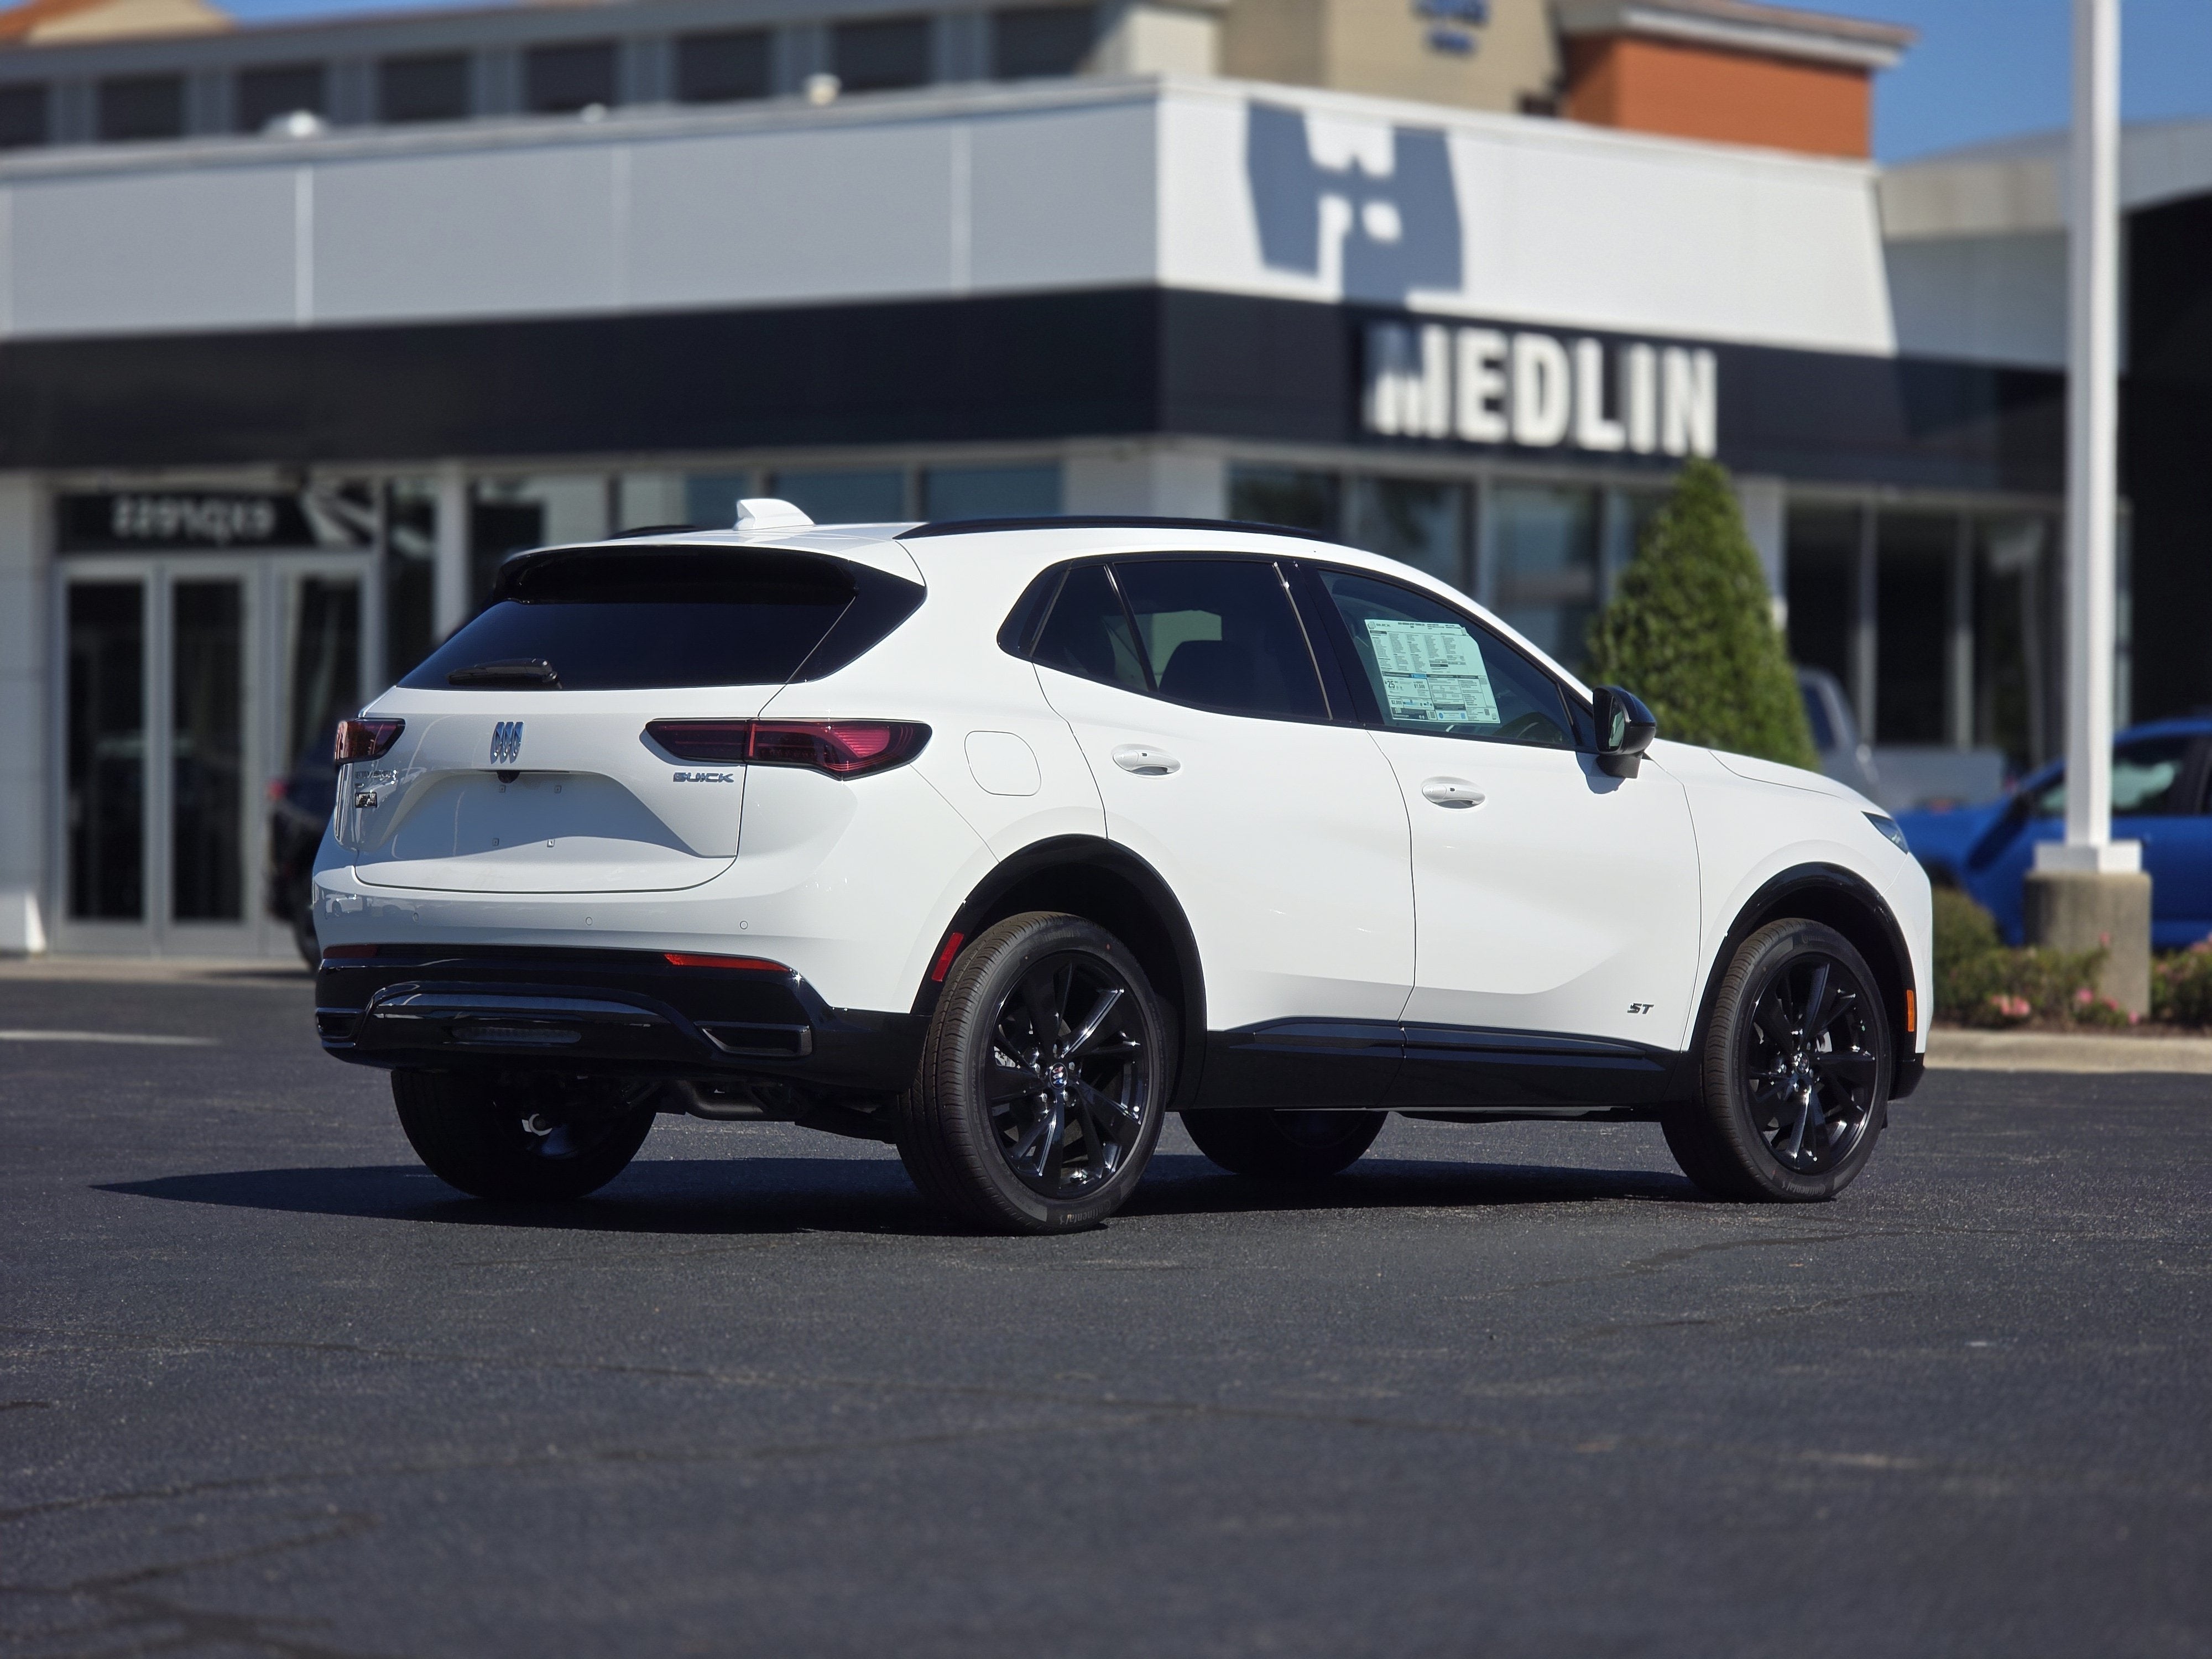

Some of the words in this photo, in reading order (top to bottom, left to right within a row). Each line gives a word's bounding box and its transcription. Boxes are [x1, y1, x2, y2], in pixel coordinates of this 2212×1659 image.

[1366, 323, 1718, 458] MEDLIN
[1387, 680, 1395, 688] 25
[673, 772, 734, 782] BUICK
[1627, 1003, 1654, 1014] ST
[1786, 1181, 1827, 1197] Continental
[1065, 1199, 1112, 1225] Continental
